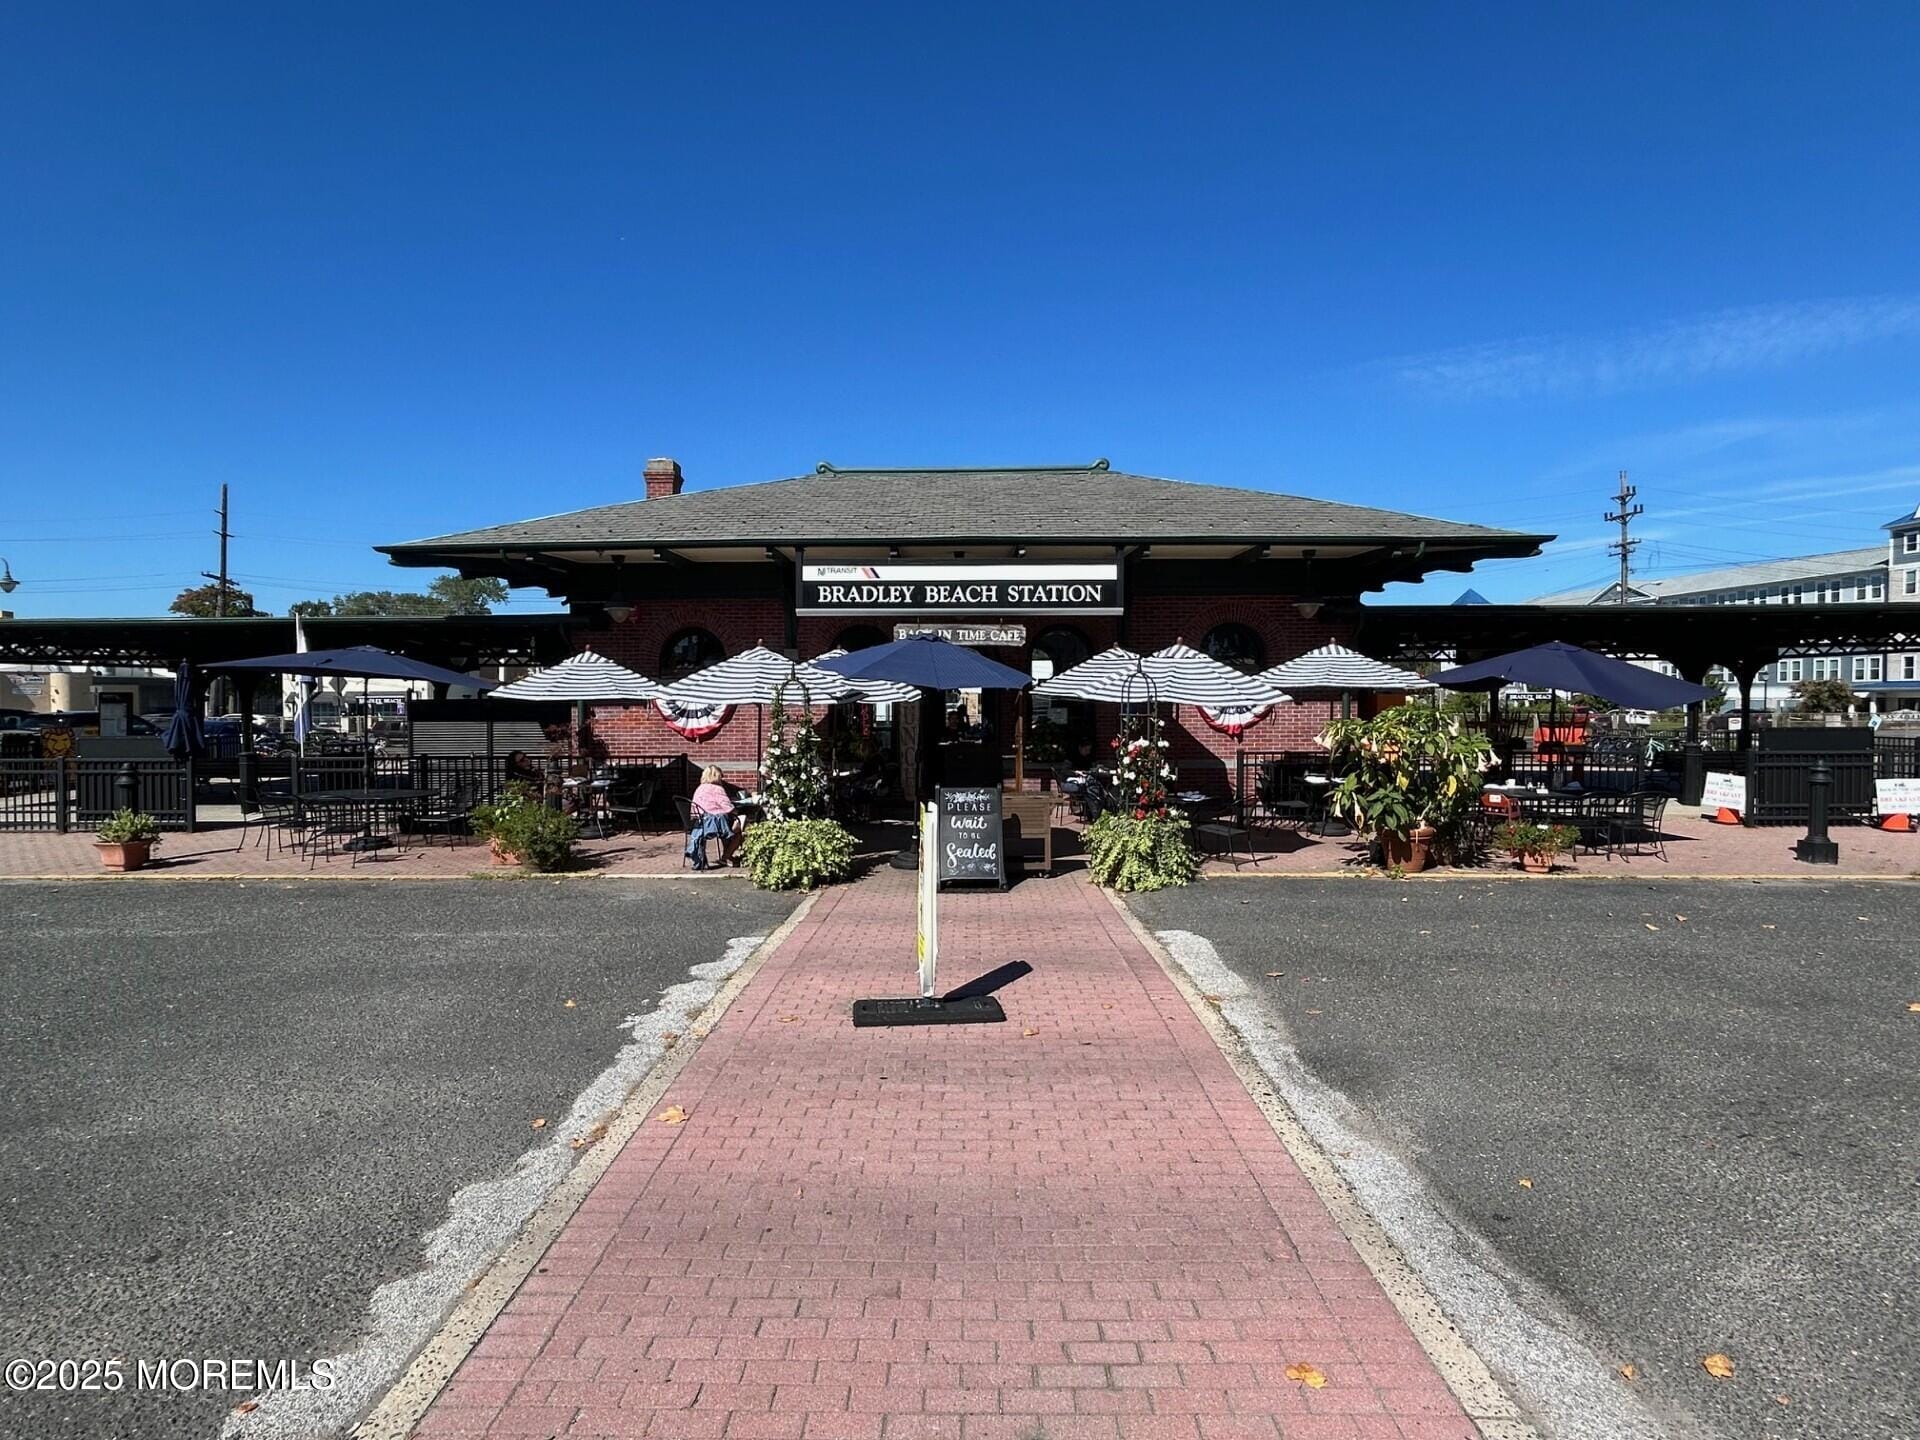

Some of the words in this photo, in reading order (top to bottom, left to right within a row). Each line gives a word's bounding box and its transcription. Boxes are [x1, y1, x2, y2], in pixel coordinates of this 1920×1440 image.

[817, 585, 914, 603] BRADLEY
[924, 585, 998, 603] BEACH
[1007, 585, 1102, 602] STATION
[938, 629, 952, 640] IN
[957, 630, 986, 641] TIME
[990, 629, 1021, 641] CAFE
[947, 802, 991, 812] PLEASE
[946, 842, 996, 869] Seated
